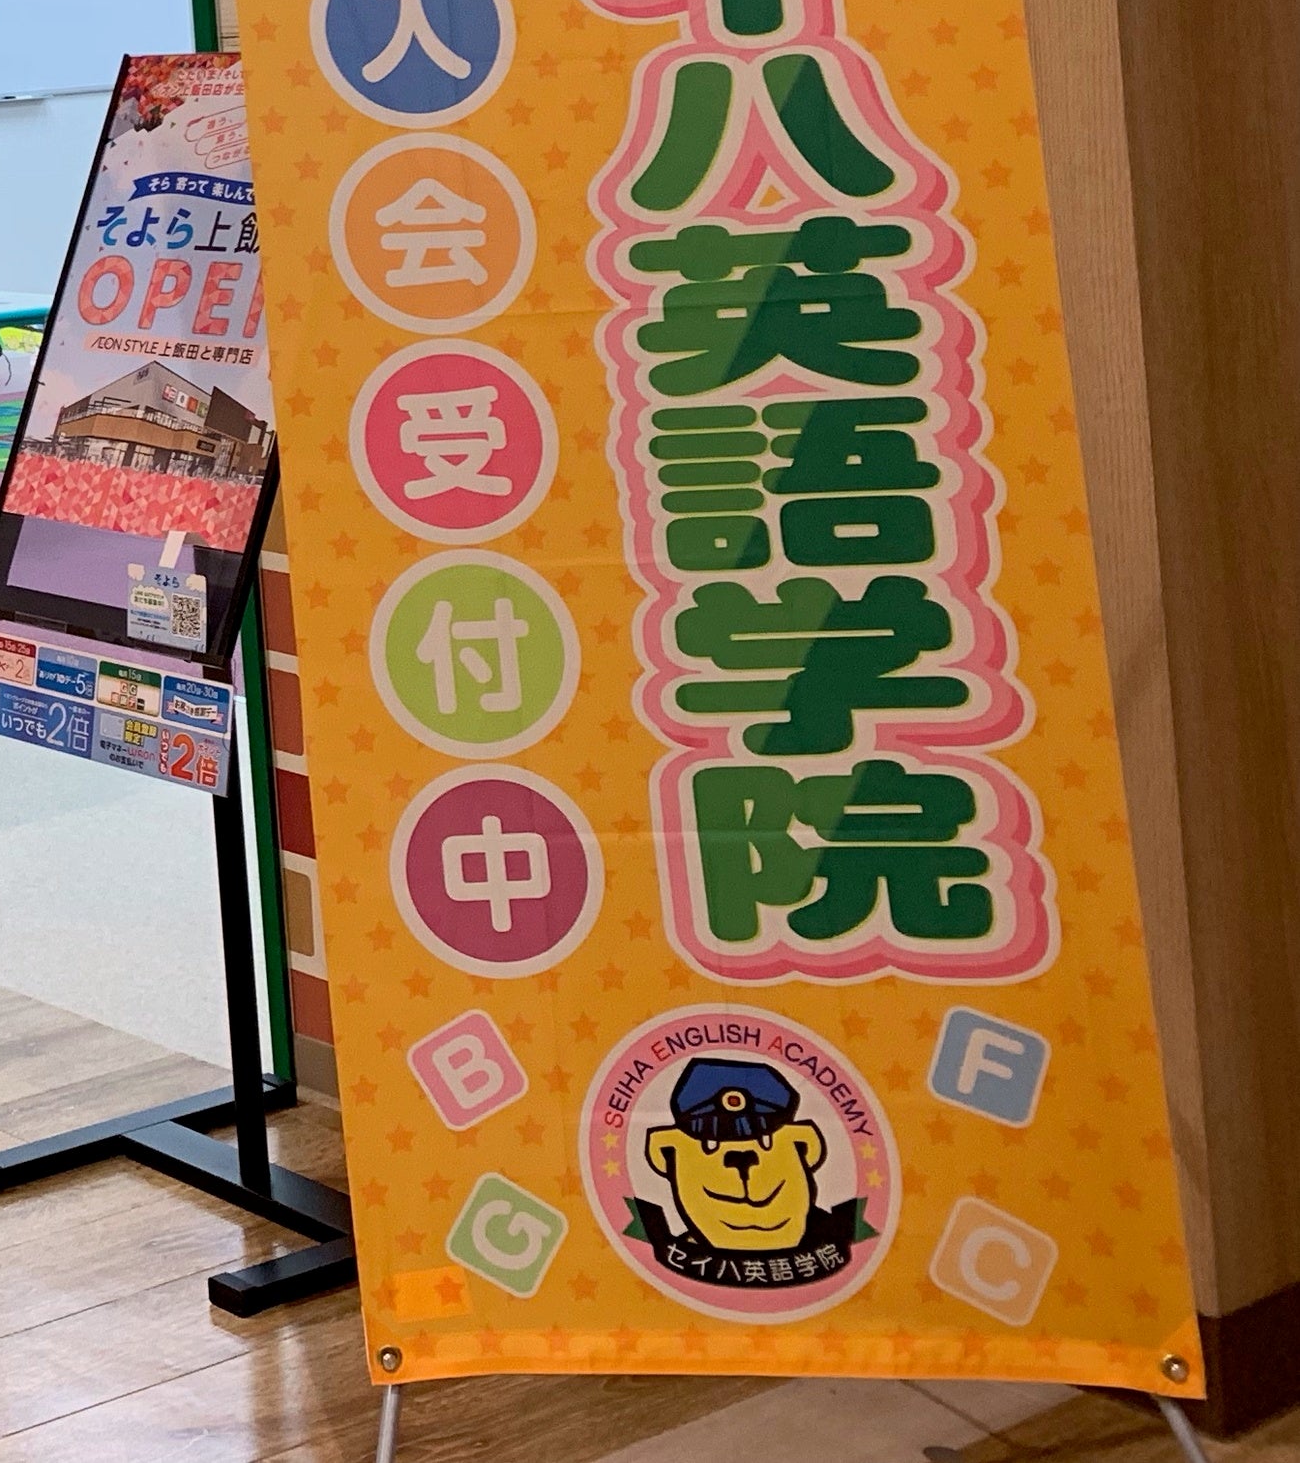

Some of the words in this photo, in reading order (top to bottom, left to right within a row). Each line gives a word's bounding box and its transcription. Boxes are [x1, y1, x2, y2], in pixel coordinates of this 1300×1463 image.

[124, 339, 159, 355] STYLE
[158, 341, 254, 365] 上飯田と専門店
[604, 1058, 654, 1129] SEIHA
[650, 1023, 762, 1063] ENGLISH
[767, 1034, 874, 1138] ACADEMY
[962, 1028, 1026, 1097] F
[471, 1195, 548, 1274] G
[667, 1240, 845, 1284] セイハ英語学院
[960, 1222, 1033, 1303] C
